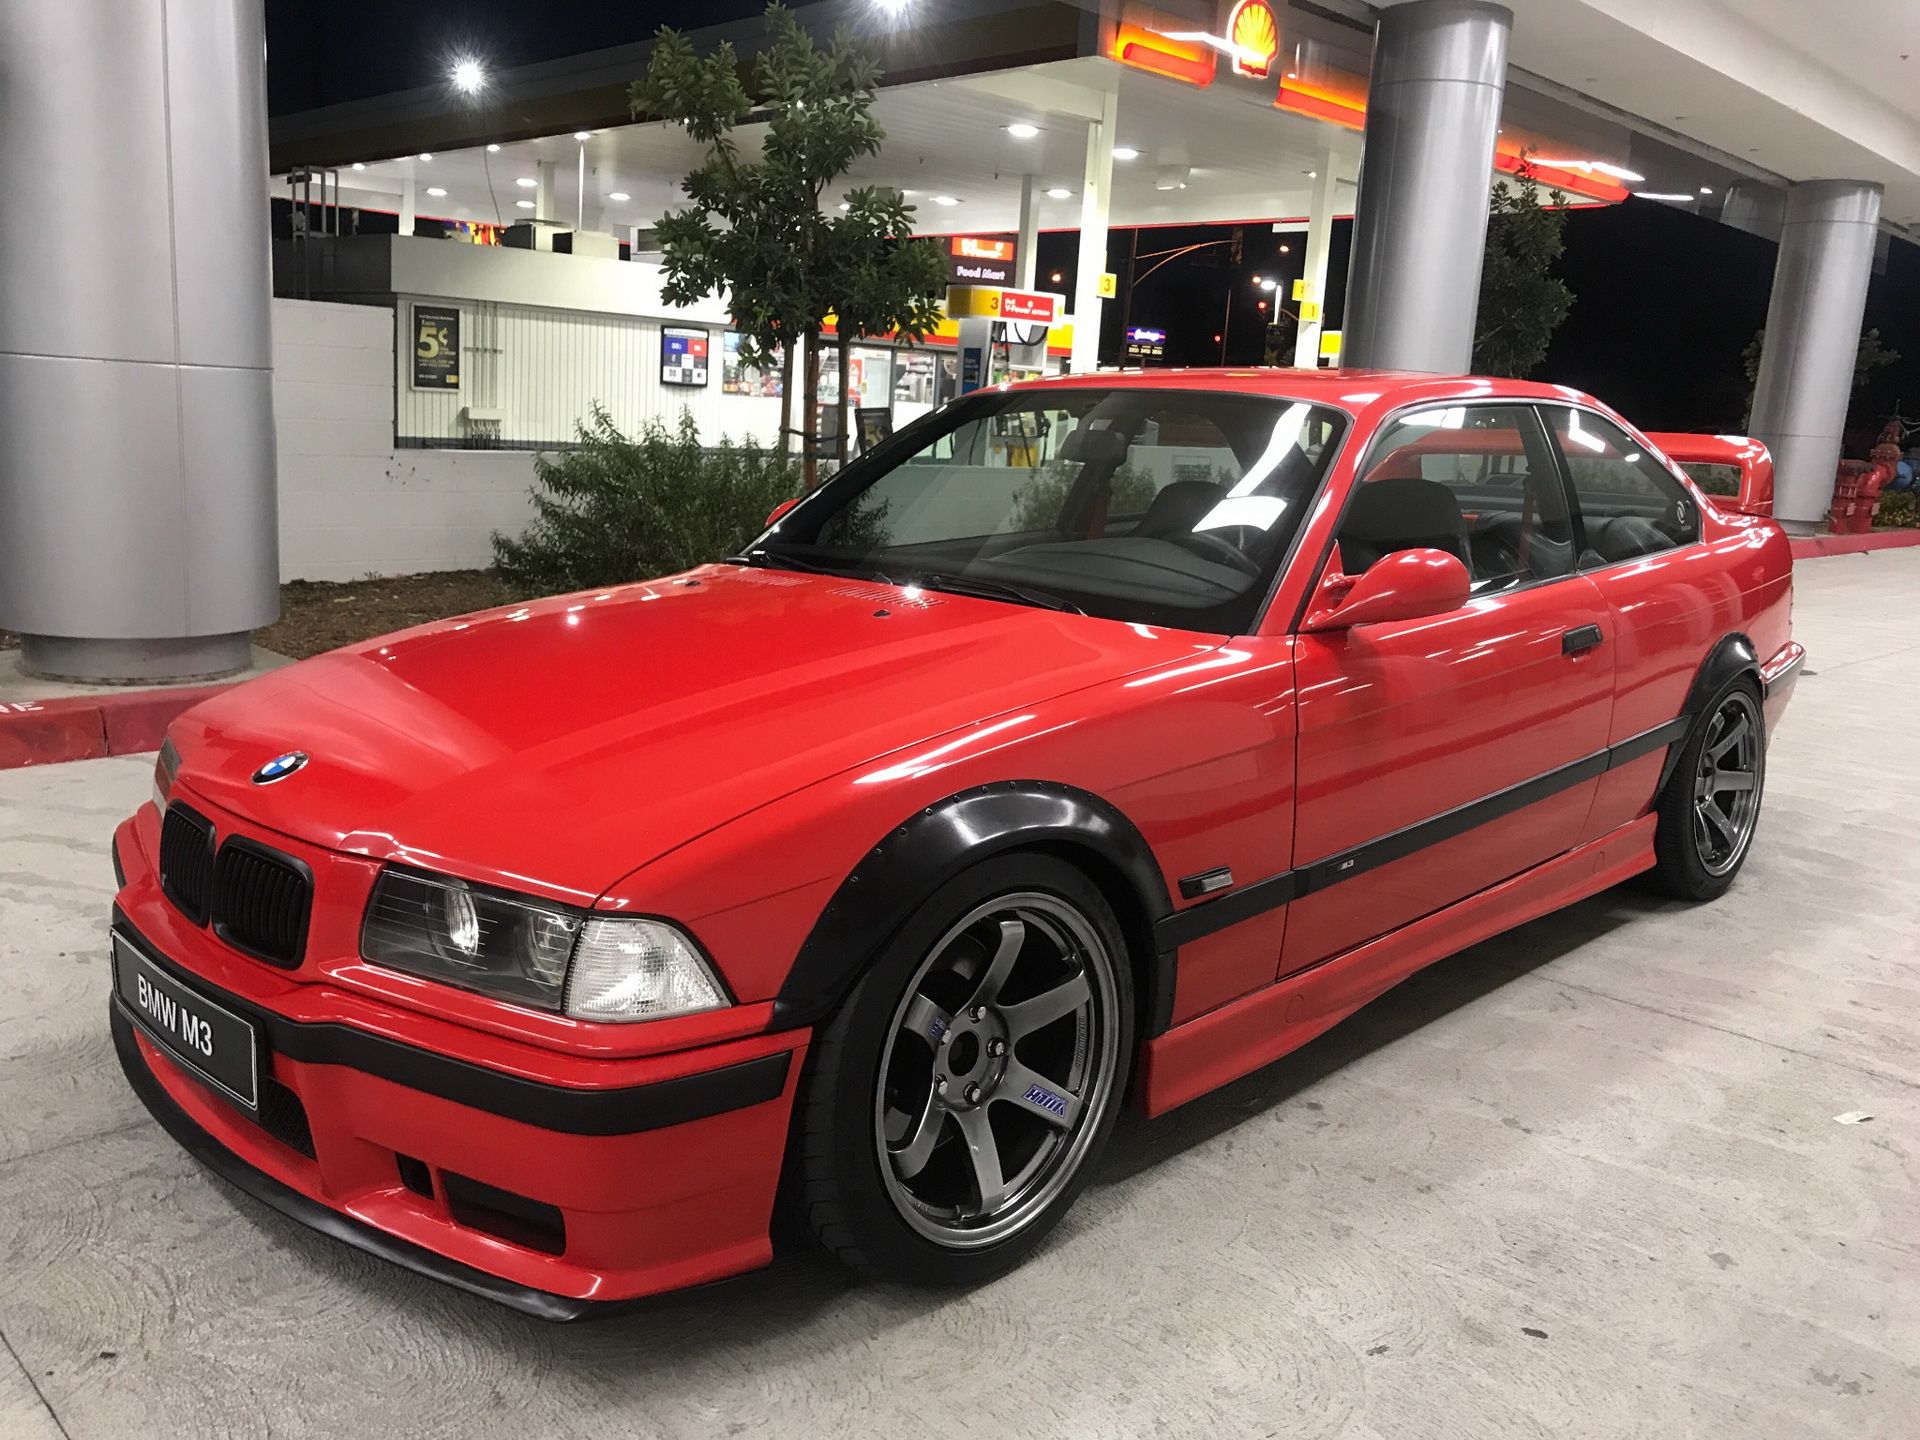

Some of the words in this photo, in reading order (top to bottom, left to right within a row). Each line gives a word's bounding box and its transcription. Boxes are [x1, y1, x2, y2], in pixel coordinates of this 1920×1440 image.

[957, 265, 981, 278] Food
[982, 269, 1005, 280] Mart
[1104, 278, 1111, 292] 3
[990, 297, 999, 310] 3
[138, 973, 176, 1033] BMW
[181, 1007, 213, 1057] M3
